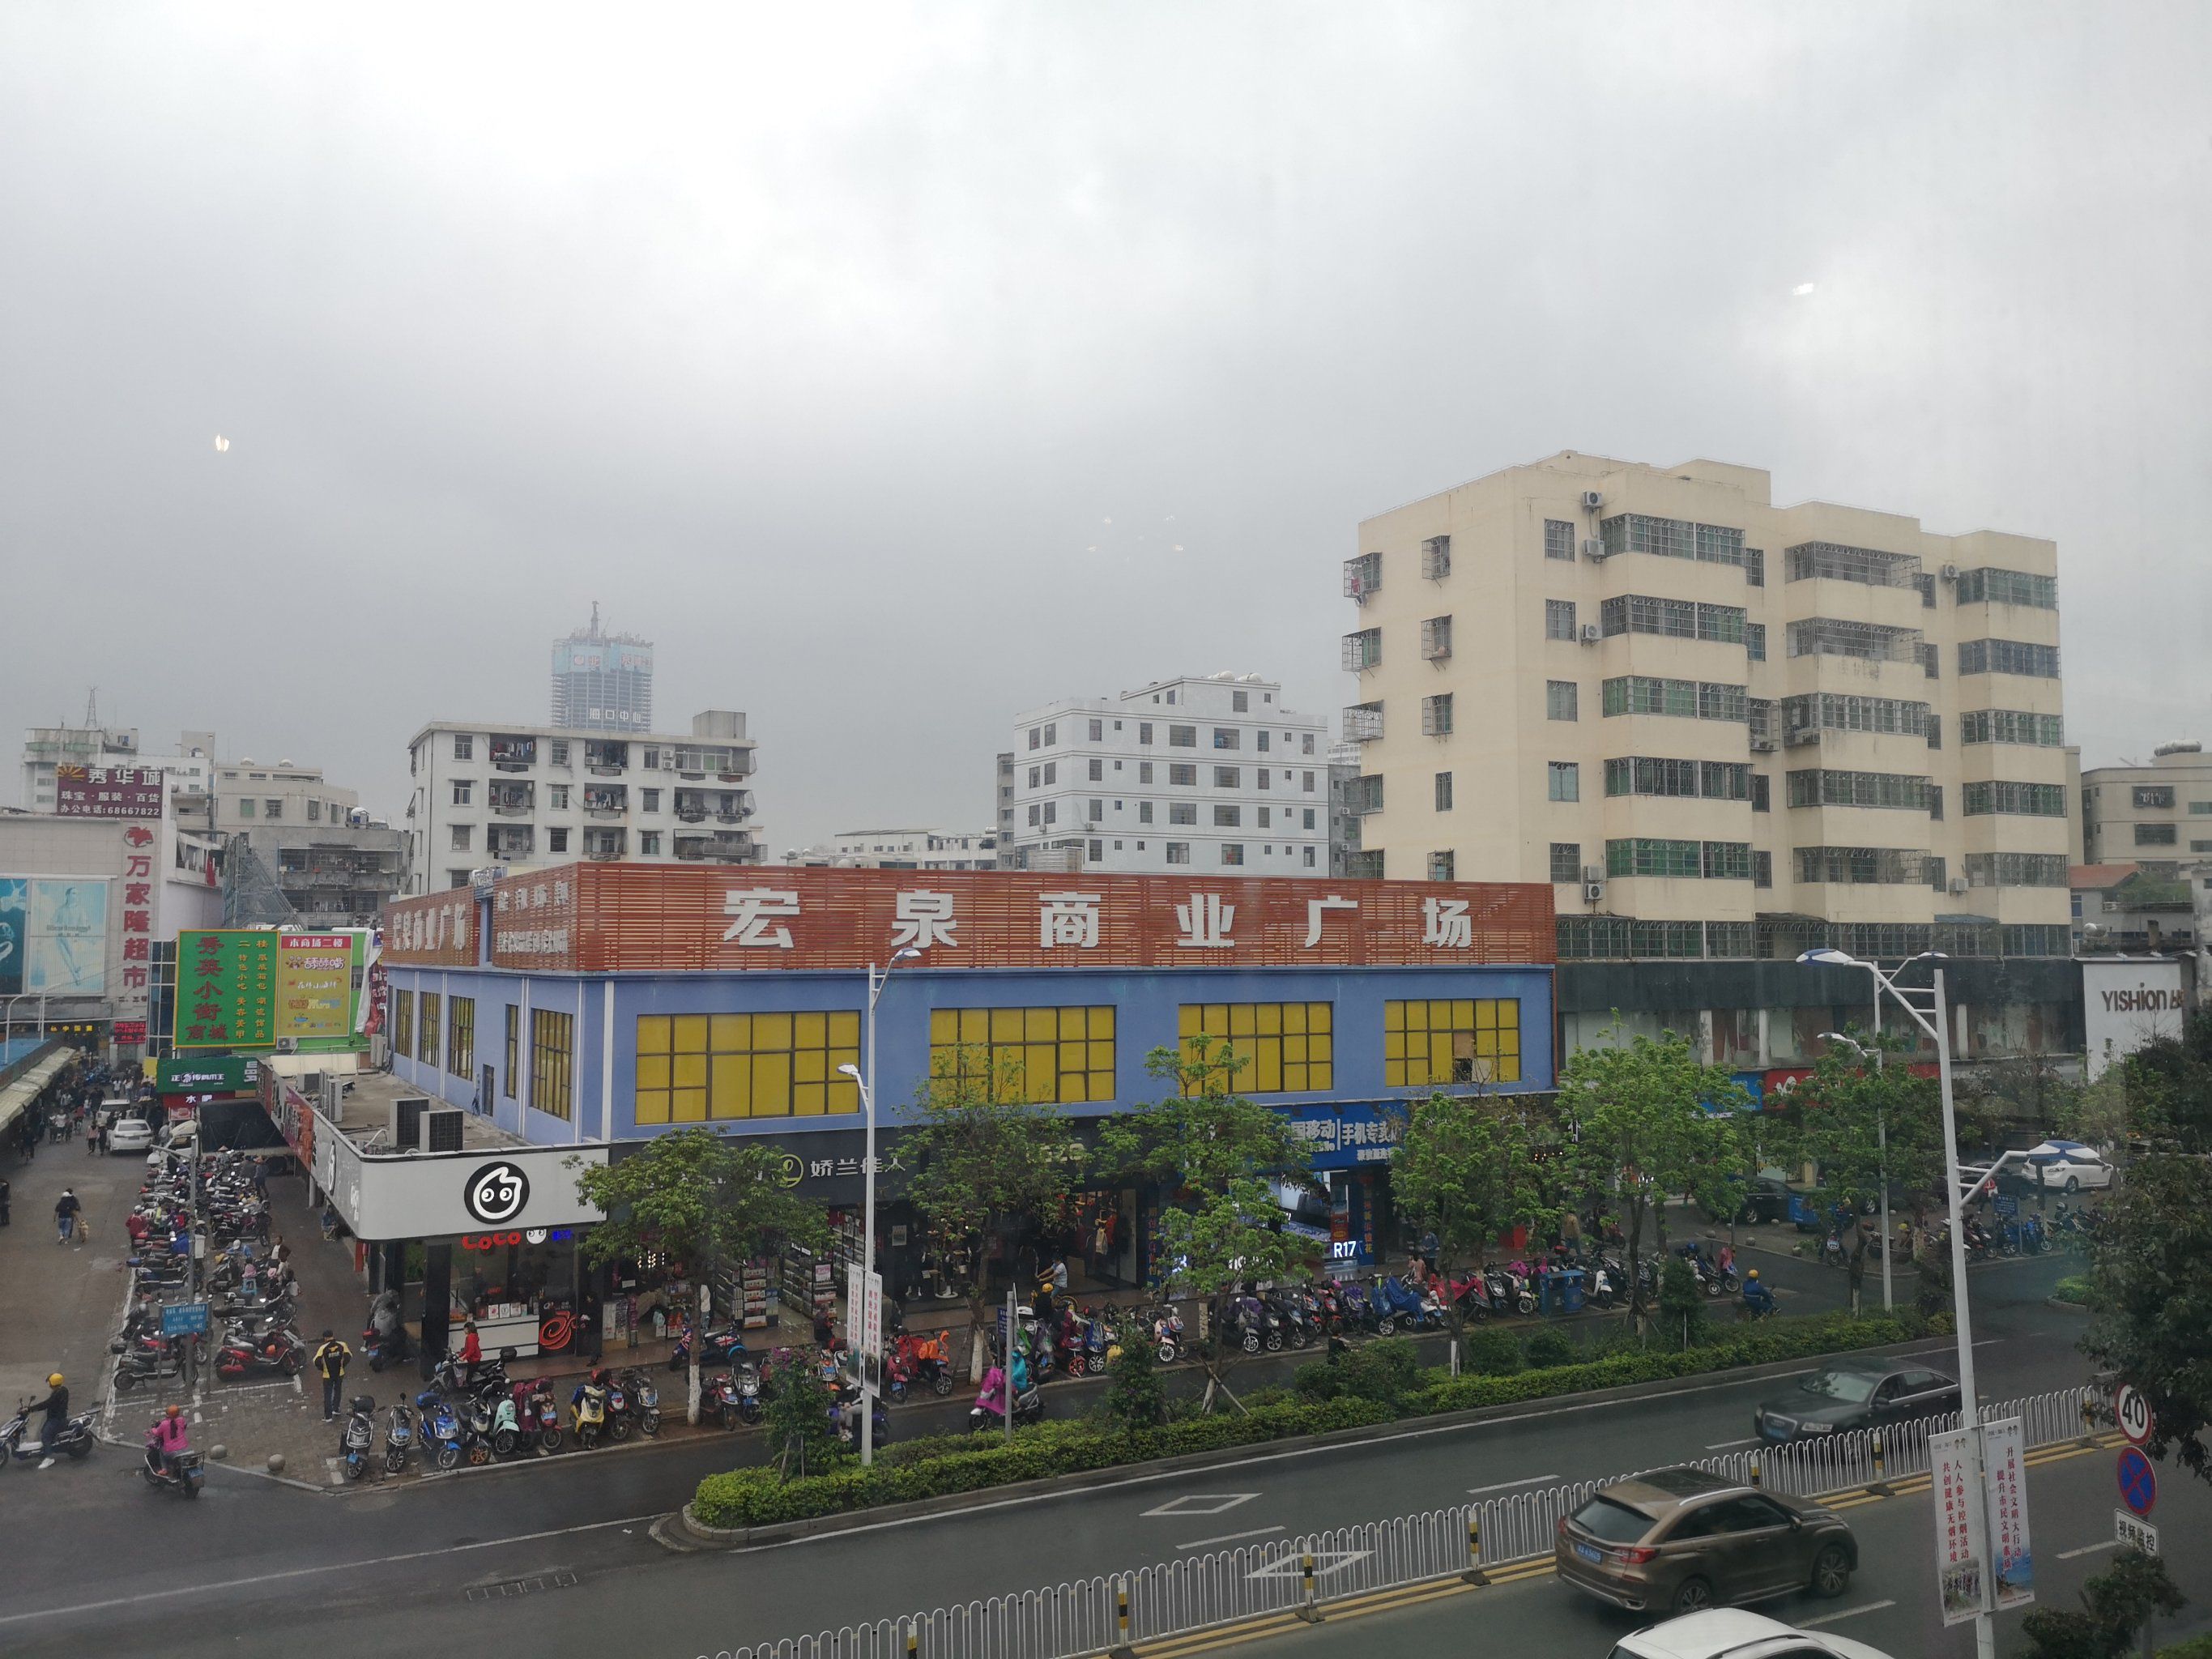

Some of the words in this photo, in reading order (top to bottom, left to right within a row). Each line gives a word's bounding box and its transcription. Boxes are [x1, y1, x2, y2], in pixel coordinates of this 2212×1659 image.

[87, 768, 161, 786] 秀华城
[123, 855, 152, 989] 万家隆超市
[722, 888, 1472, 949] 宏泉商业广场
[194, 936, 225, 1021] 秀英小街
[1333, 1240, 1357, 1258] R17
[2122, 1393, 2146, 1429] 40
[1954, 1460, 1970, 1560] 人人参与控烟活动
[1997, 1469, 2013, 1570] 提升市民文明素质
[2005, 1446, 2022, 1559] 开展社会文明大行动
